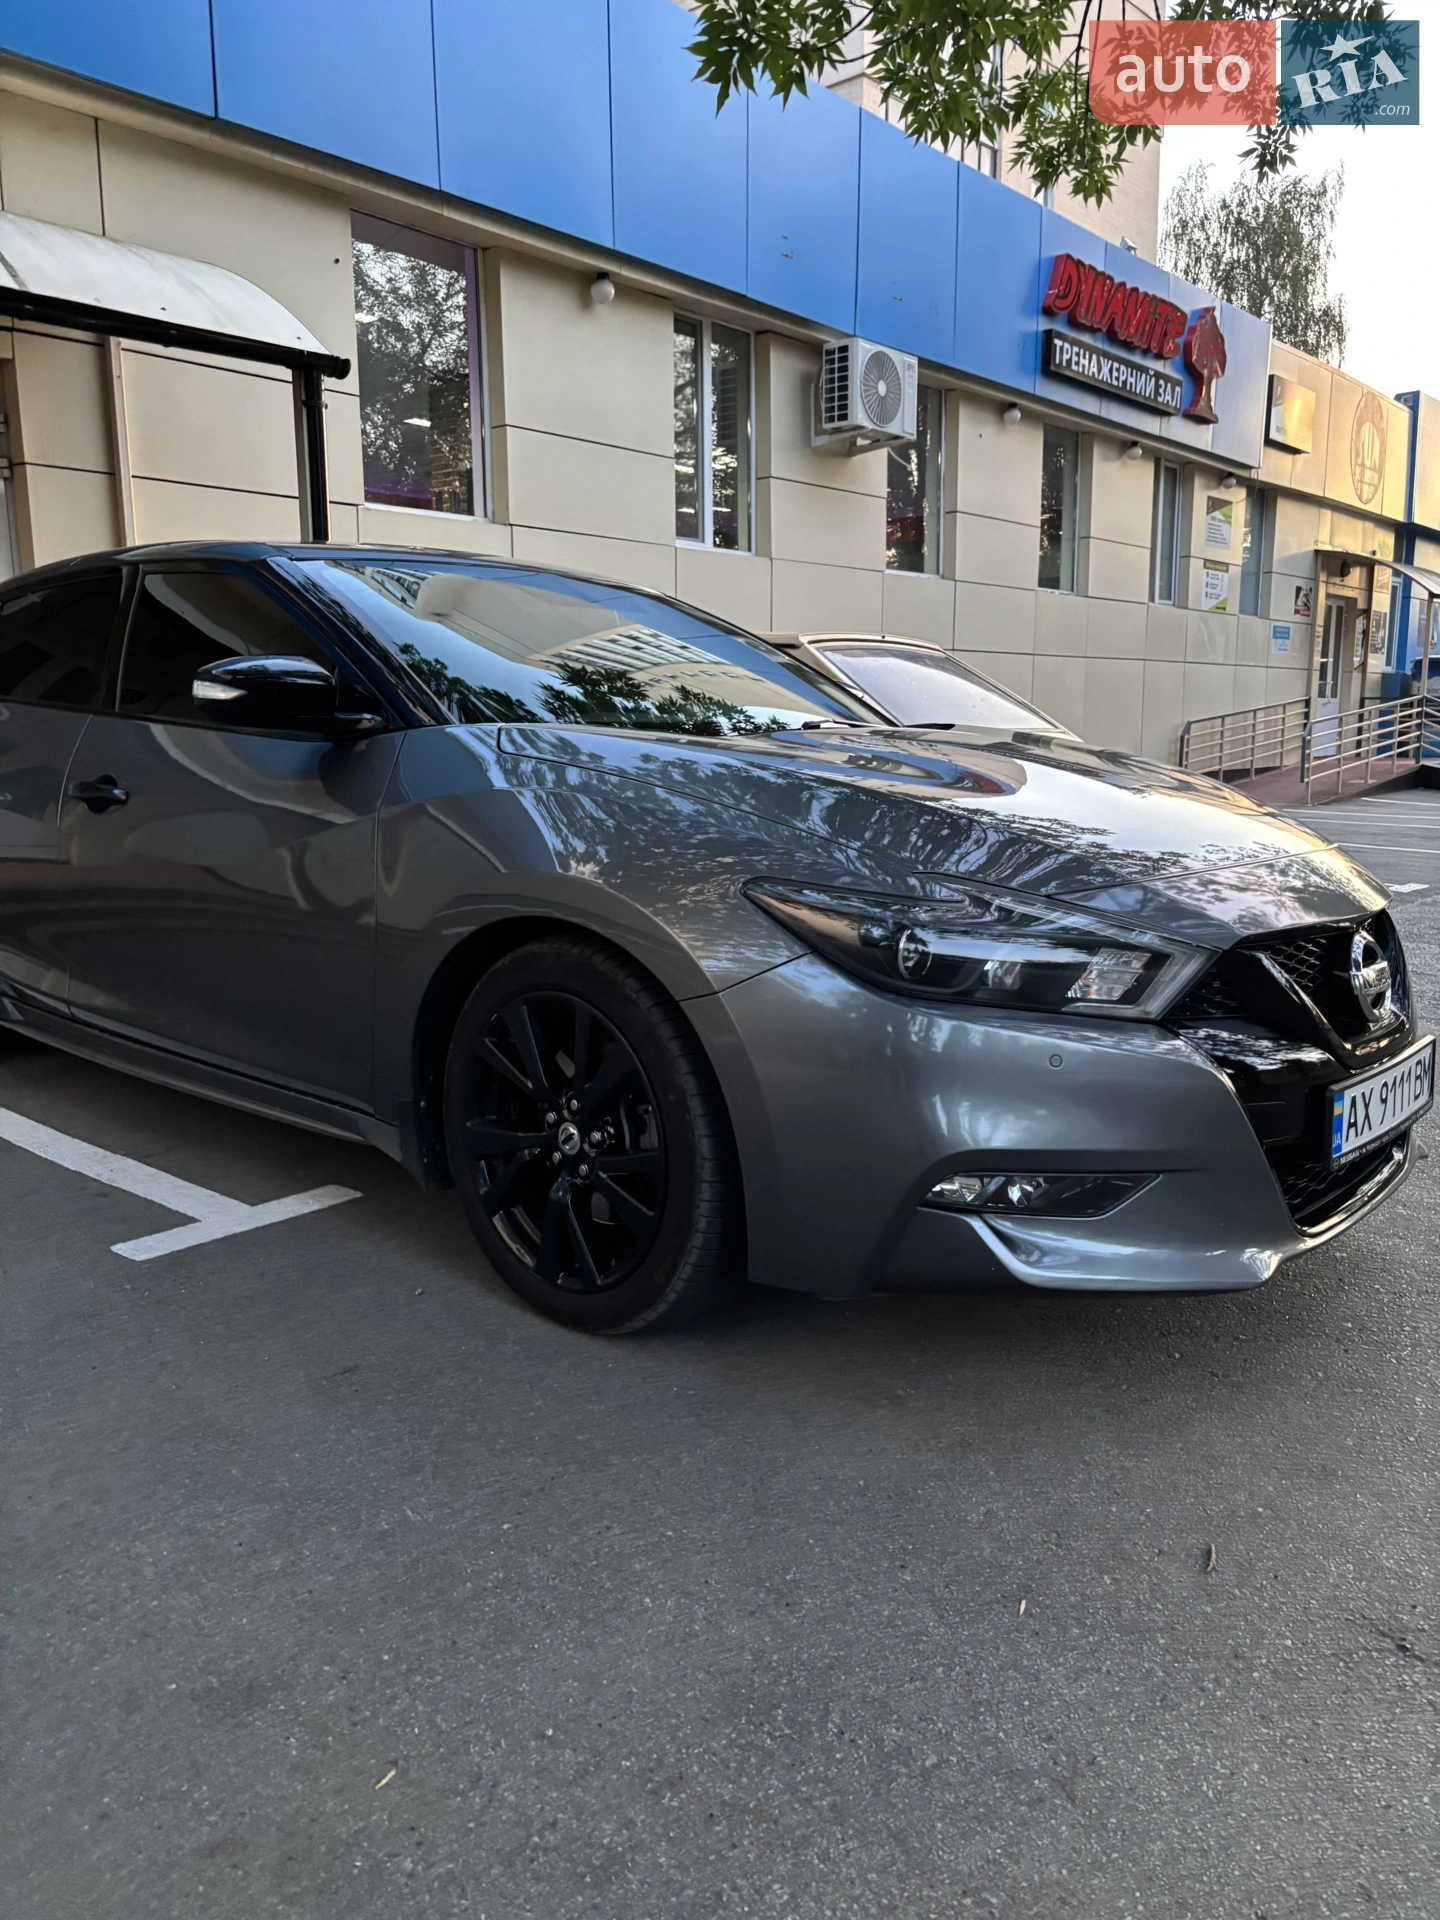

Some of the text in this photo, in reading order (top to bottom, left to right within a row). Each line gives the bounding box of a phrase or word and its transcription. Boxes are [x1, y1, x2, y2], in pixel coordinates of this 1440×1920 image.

[1054, 338, 1182, 409] ТРЕНАЖЕРНИЙ ЗАЛ
[1345, 1086, 1374, 1143] AX
[1380, 1065, 1412, 1125] 9111
